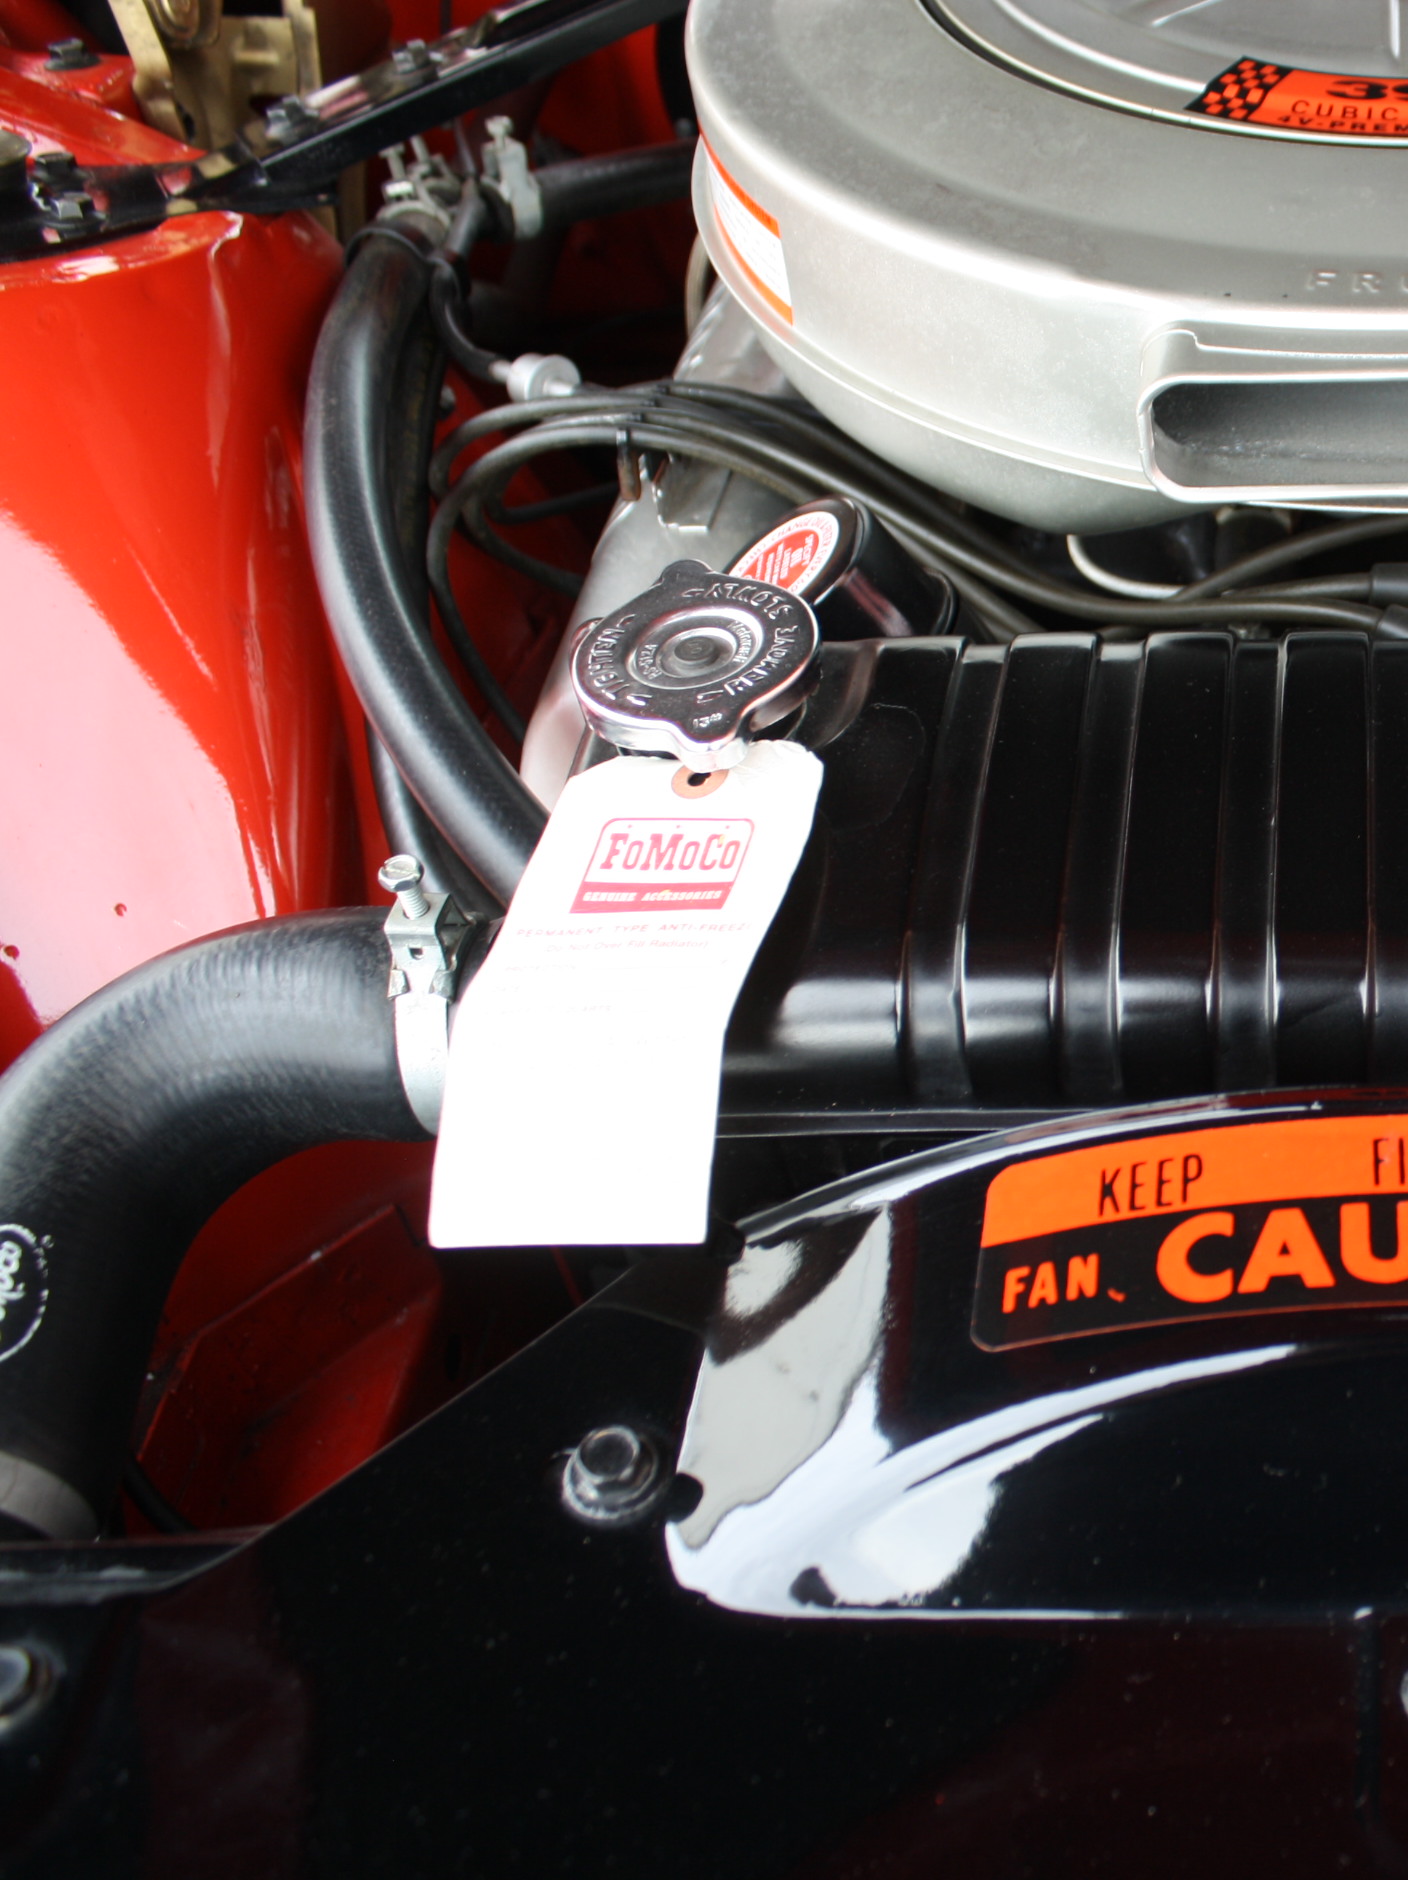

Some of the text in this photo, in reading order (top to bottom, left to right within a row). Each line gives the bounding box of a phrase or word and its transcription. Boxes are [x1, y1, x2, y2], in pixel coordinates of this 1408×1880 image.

[1291, 100, 1399, 121] CUBIC
[588, 626, 626, 700] TIGHTEN
[724, 625, 798, 695] REMOVE
[599, 833, 741, 871] FoMoCo
[583, 889, 723, 902] GENUINE ACCESSORIES
[516, 926, 603, 938] PERMANENT
[614, 924, 649, 932] TYPE
[1098, 1153, 1204, 1217] KEEP
[1001, 1253, 1102, 1314] FAN
